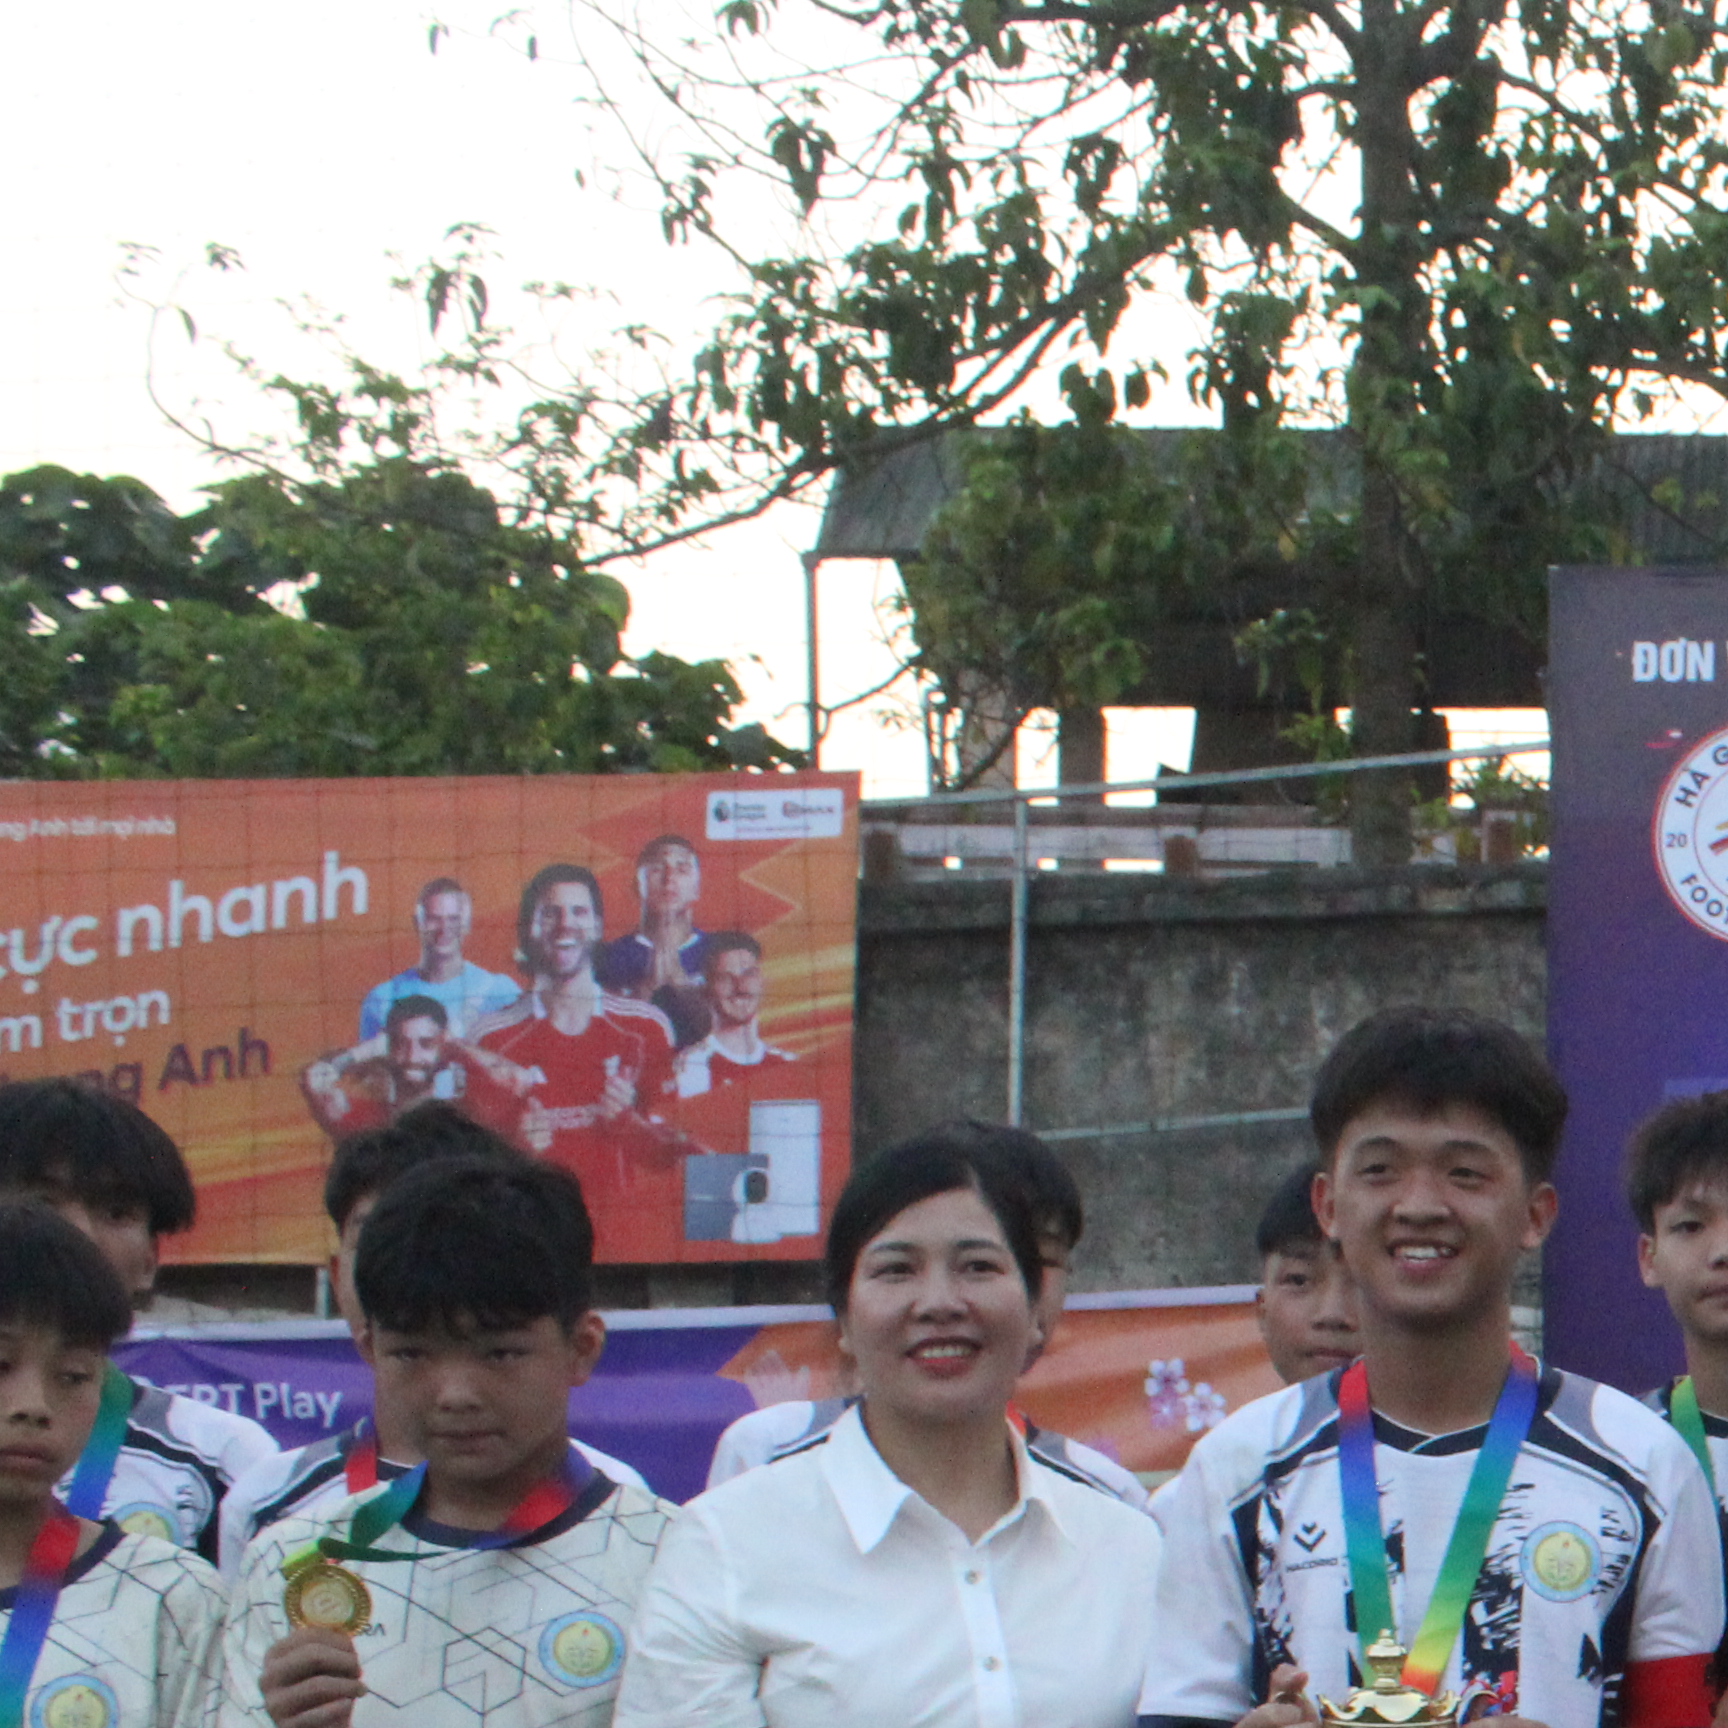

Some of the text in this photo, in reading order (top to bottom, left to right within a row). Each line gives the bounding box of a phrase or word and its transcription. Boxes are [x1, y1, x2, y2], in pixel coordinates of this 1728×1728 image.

[1632, 636, 1713, 682] ĐƠN
[1666, 833, 1688, 848] 20
[0, 850, 369, 995] ực nhanh
[57, 989, 171, 1047] trọn
[159, 1026, 272, 1091] Anh
[253, 1382, 344, 1428] Play
